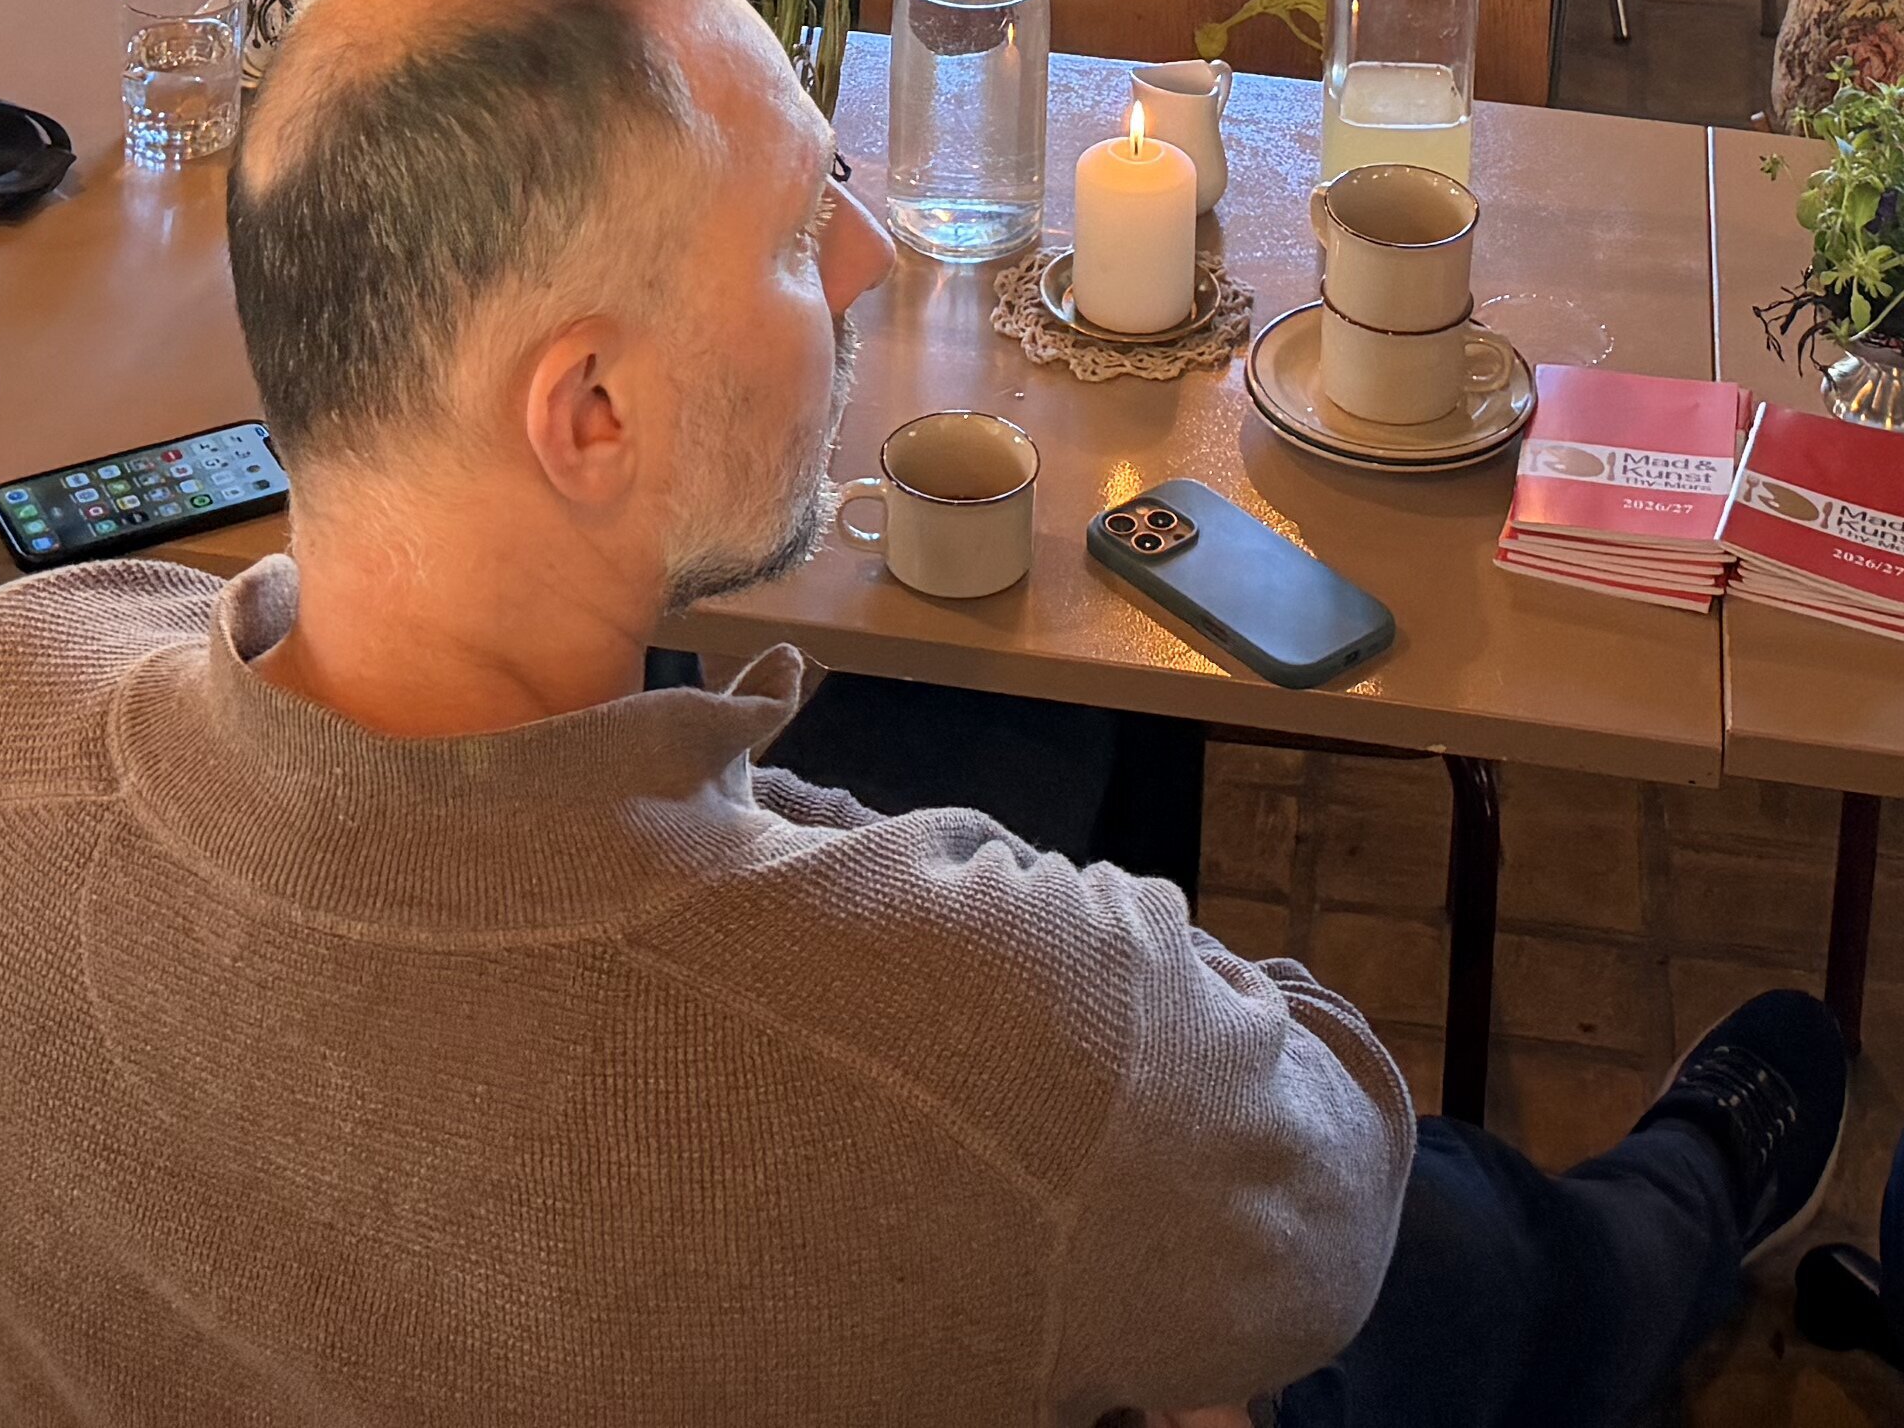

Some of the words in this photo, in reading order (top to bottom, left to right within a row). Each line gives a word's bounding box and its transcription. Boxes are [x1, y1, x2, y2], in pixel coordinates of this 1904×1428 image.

[1623, 452, 1690, 470] Mad
[1694, 459, 1717, 472] &
[1622, 464, 1713, 484] Kunst
[1623, 498, 1694, 514] 2026/27
[1832, 548, 1904, 577] 2026/27
